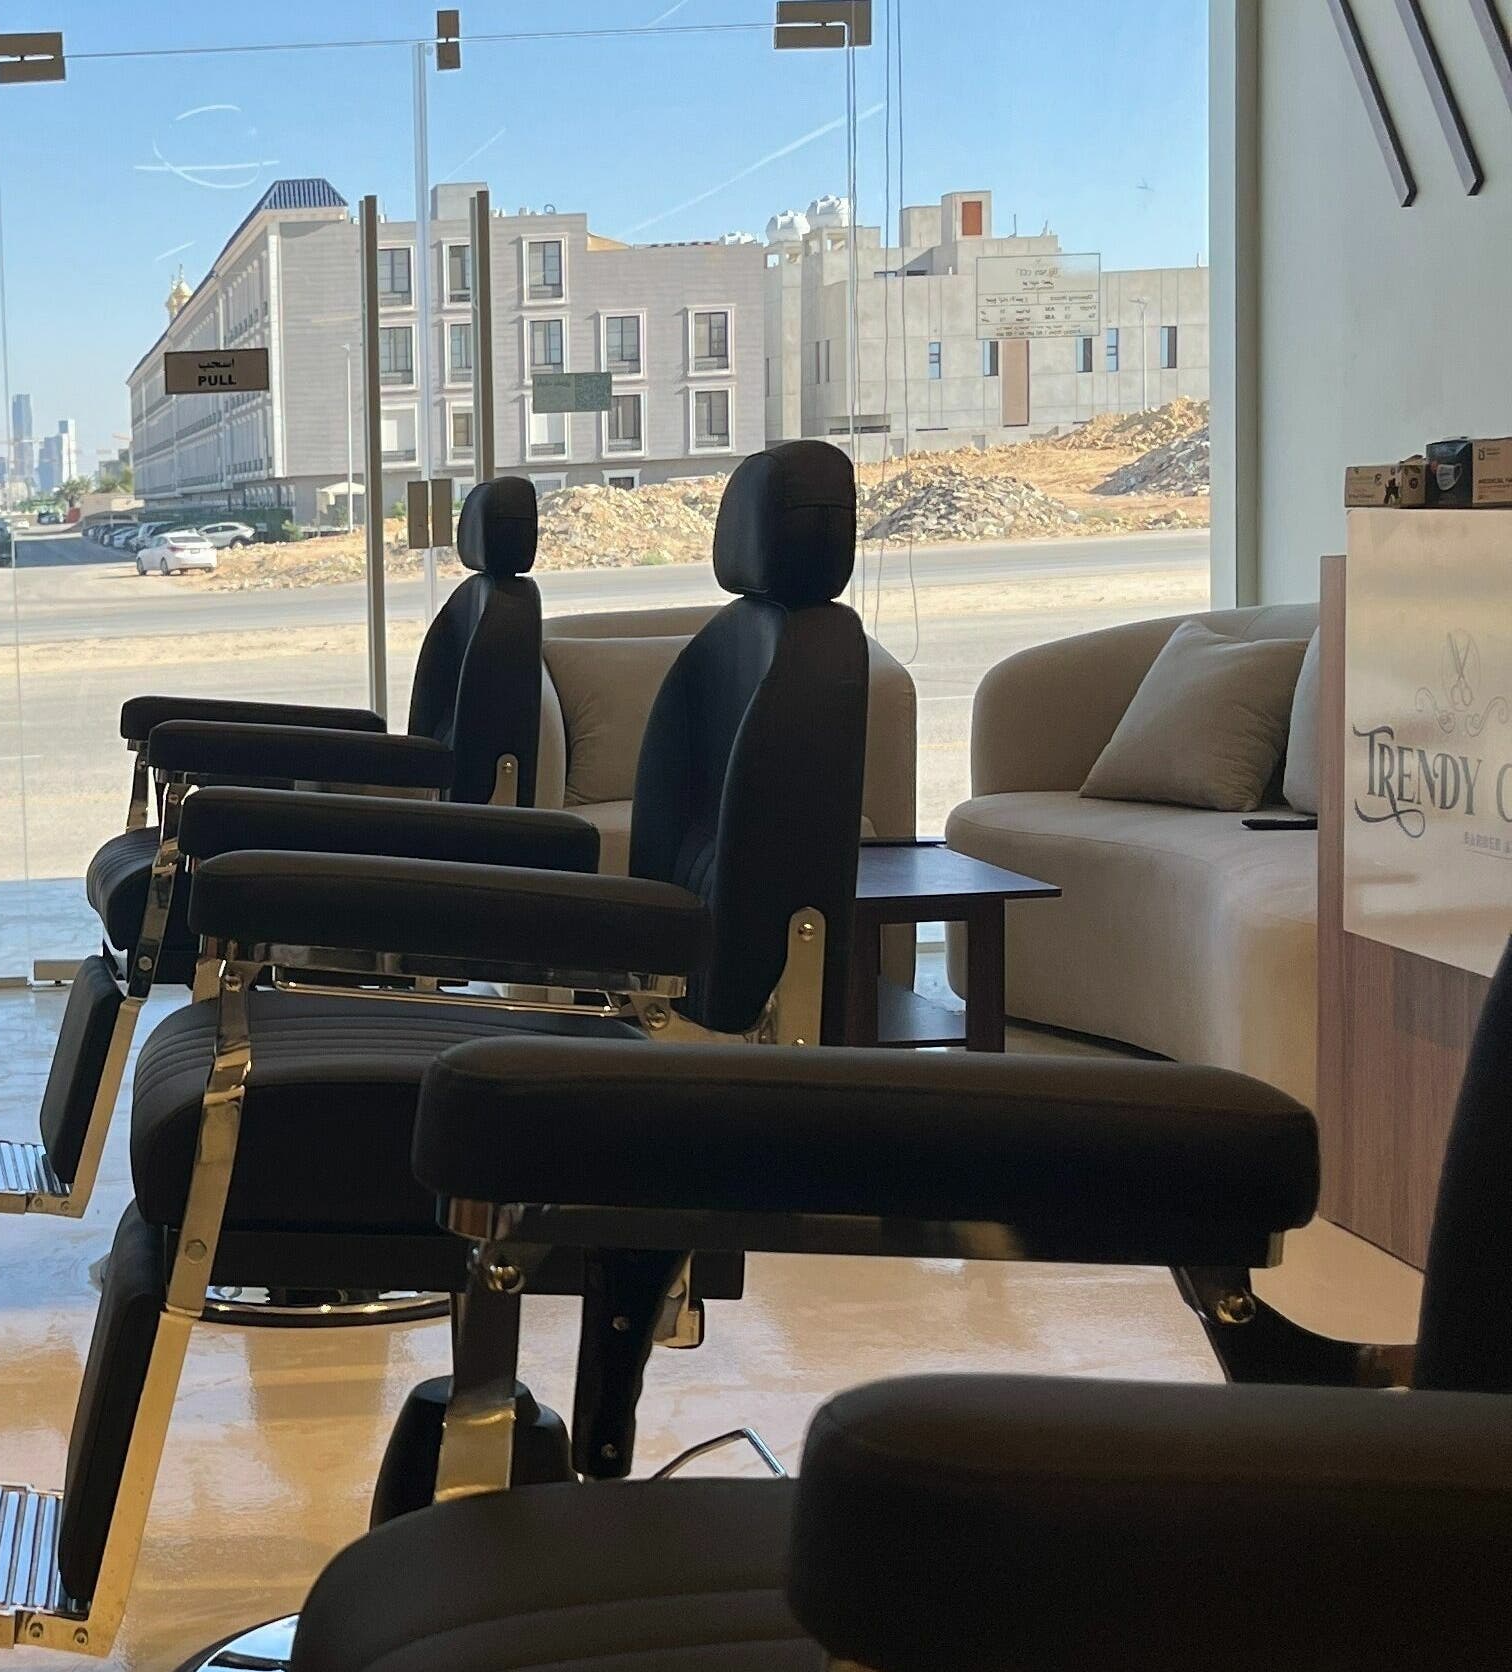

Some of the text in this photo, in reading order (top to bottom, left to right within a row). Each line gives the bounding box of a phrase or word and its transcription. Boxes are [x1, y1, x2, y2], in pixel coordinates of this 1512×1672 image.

[198, 358, 235, 372] اسحب
[198, 374, 237, 386] PULL
[1352, 723, 1482, 838] TRENDY
